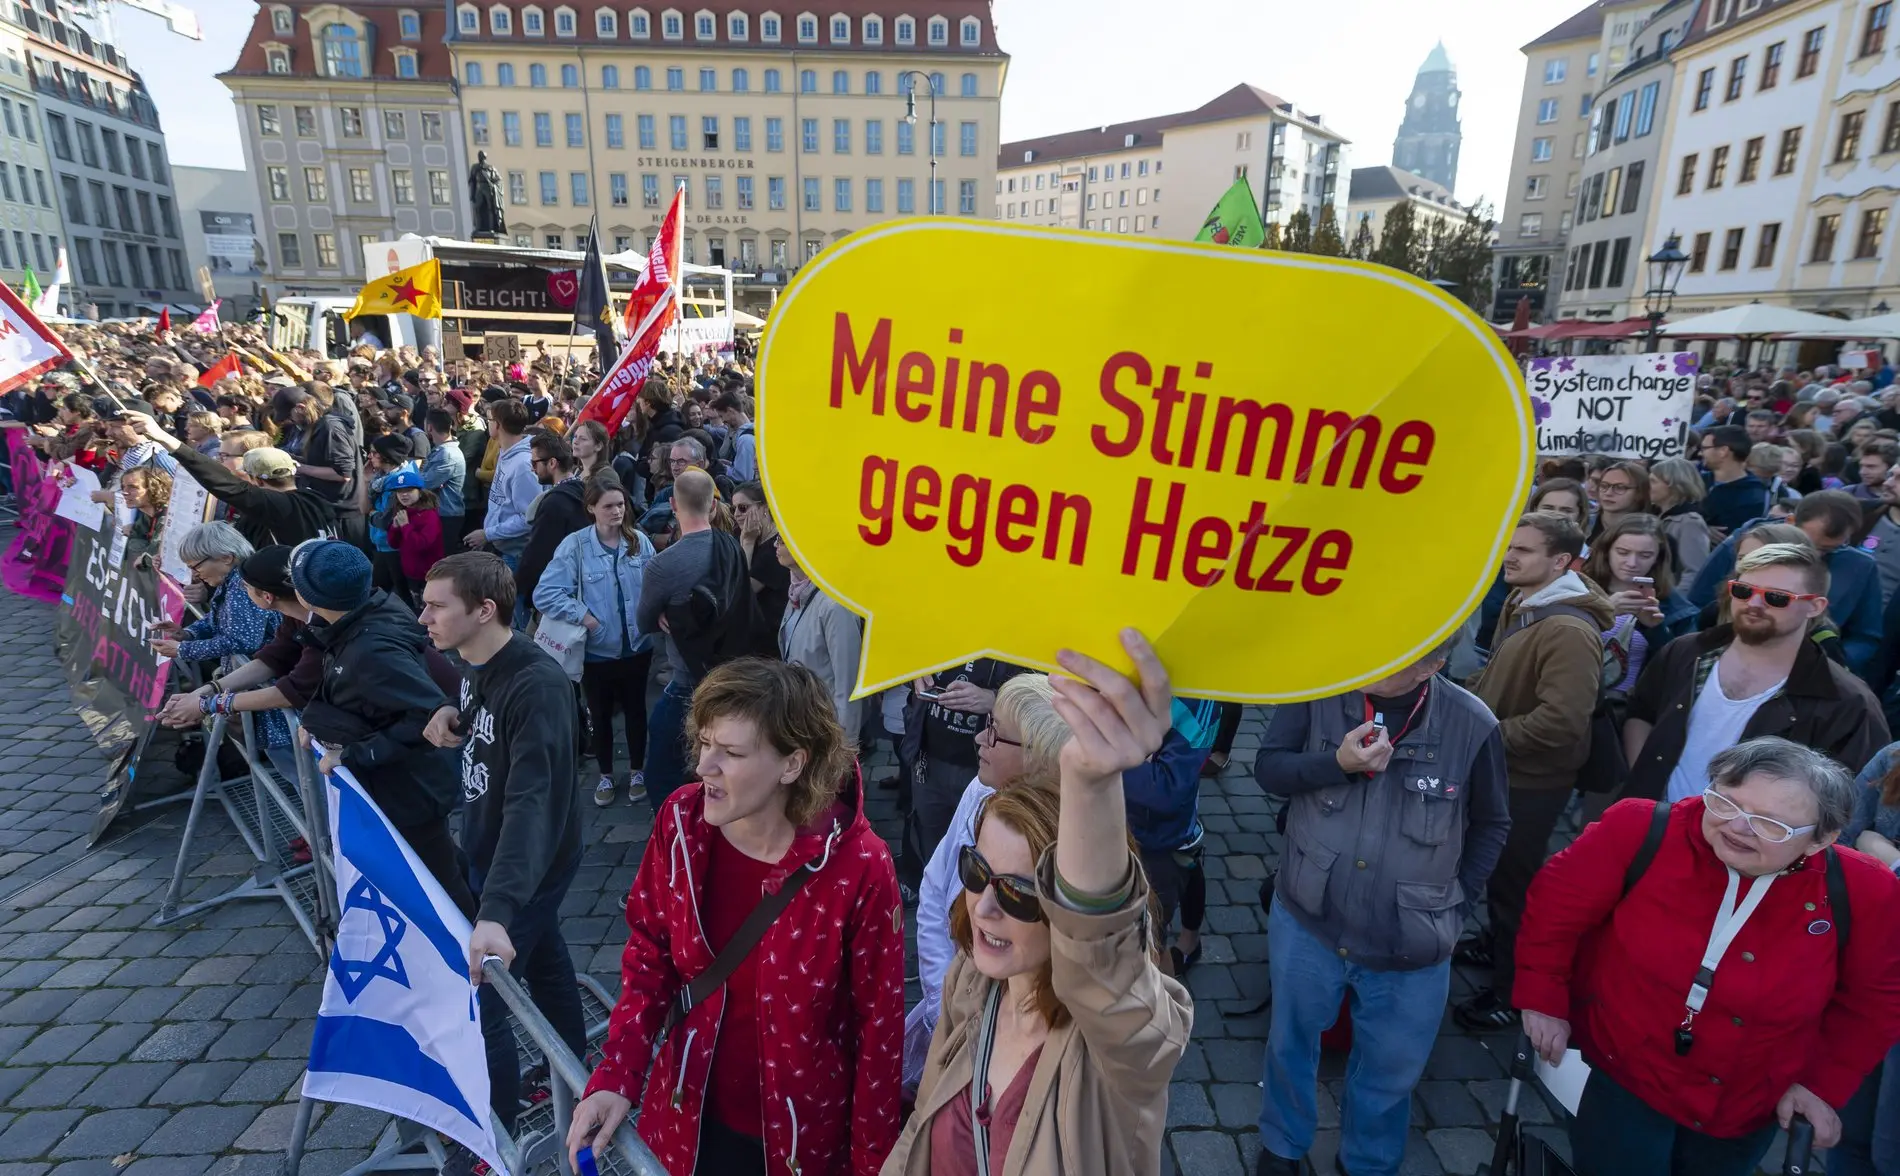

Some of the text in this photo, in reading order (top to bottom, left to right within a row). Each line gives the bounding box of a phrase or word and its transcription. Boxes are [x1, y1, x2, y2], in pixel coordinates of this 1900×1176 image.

[637, 157, 754, 169] STEIGENBERGER
[652, 214, 748, 225] HOL DE SAXE
[464, 287, 547, 308] REICHT!
[829, 312, 1436, 495] Meine Stimme
[1577, 396, 1633, 421] NOT
[1536, 426, 1595, 451] limate
[858, 455, 1353, 597] gegen Hetze
